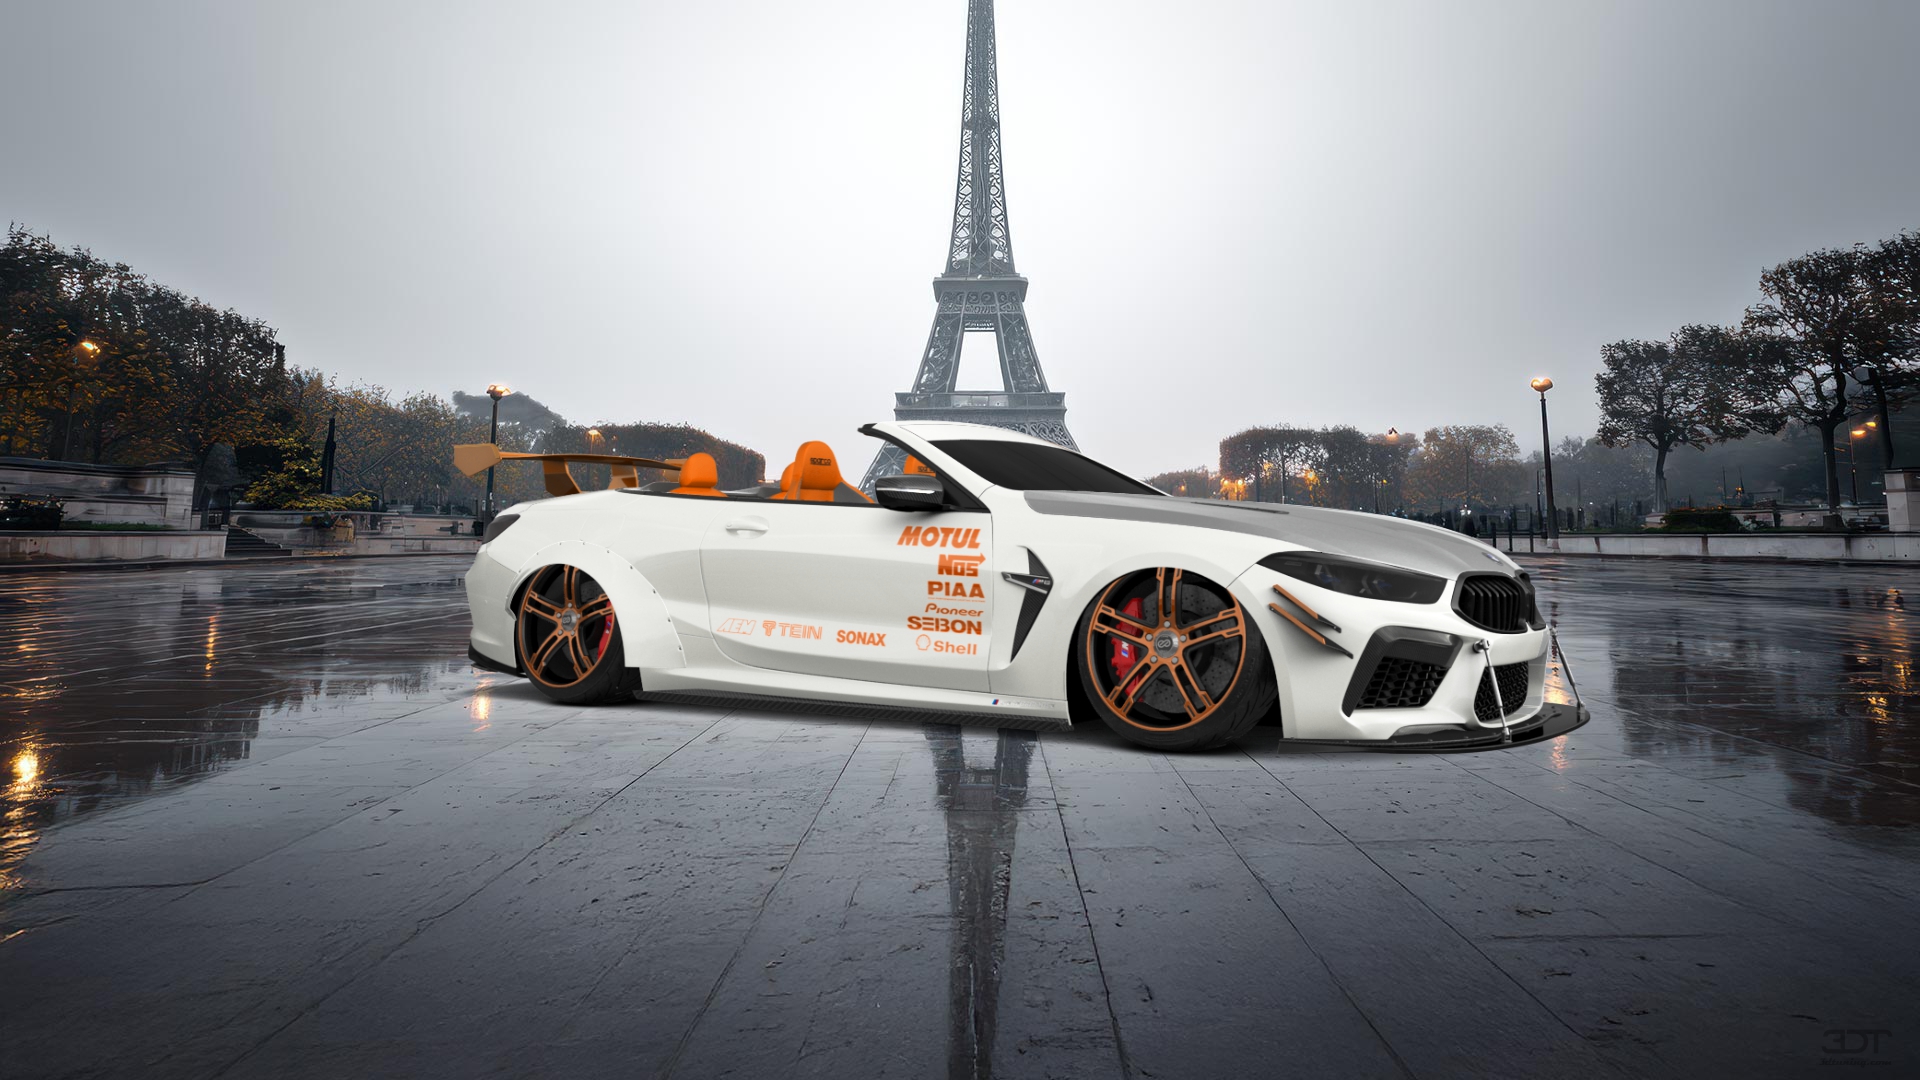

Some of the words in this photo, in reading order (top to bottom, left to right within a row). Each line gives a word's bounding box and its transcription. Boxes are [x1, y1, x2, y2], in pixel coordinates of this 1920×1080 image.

[897, 526, 981, 549] MOTUL
[938, 553, 983, 577] NOS
[927, 581, 985, 599] PIAA
[924, 602, 984, 617] Pioneer
[778, 622, 823, 640] TEIN
[907, 615, 983, 635] SEIBON
[836, 629, 887, 647] SONAX
[933, 639, 978, 655] Shell
